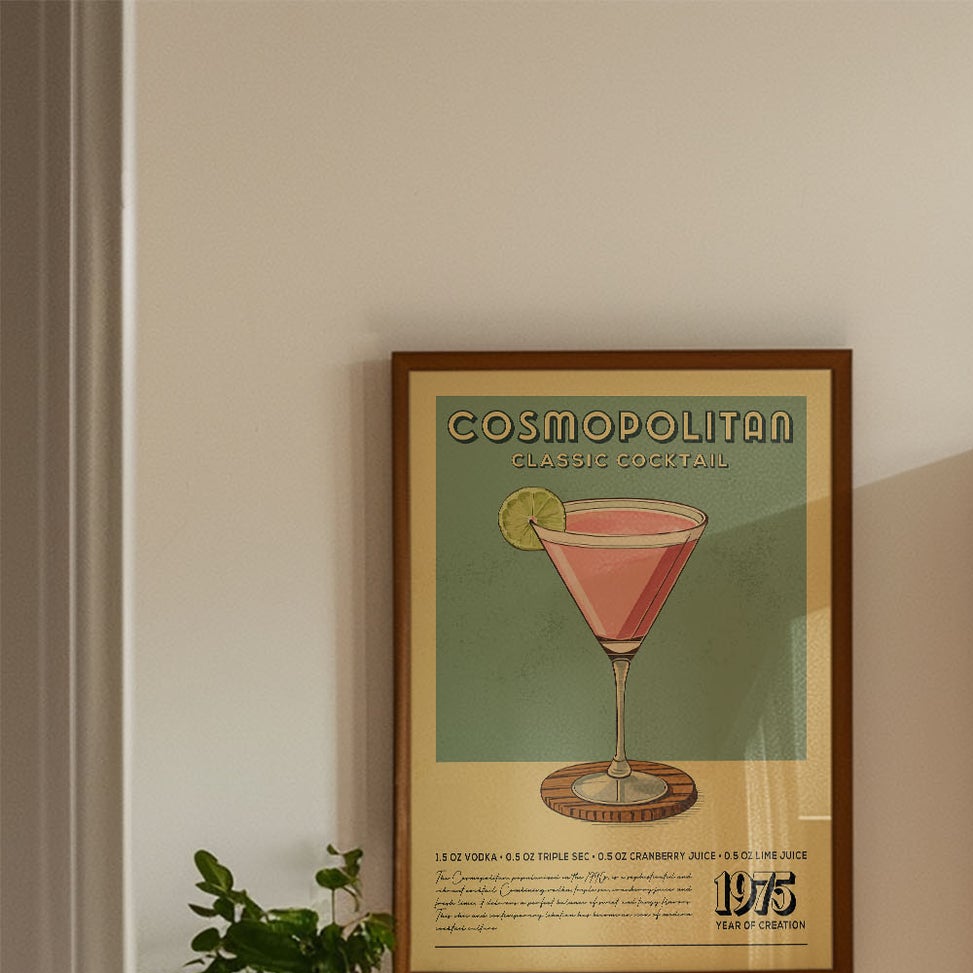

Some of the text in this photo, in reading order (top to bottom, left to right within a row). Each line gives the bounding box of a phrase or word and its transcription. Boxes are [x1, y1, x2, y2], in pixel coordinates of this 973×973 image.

[448, 409, 794, 444] COSMOPOLITAN
[511, 453, 729, 469] CLASSIC COCKTAIL
[435, 853, 448, 862] 1.5
[450, 853, 462, 861] OZ
[465, 853, 498, 862] VODKA
[506, 853, 520, 861] 0.5
[523, 853, 535, 861] OZ
[538, 852, 569, 861] TRIPLE
[571, 852, 590, 861] SEC
[598, 852, 613, 861] 0.5
[615, 852, 627, 861] OZ
[629, 852, 685, 861] CRANBERRY
[688, 851, 716, 861] JUICE
[741, 851, 754, 860] OZ
[755, 851, 777, 860] LIME
[779, 851, 807, 860] JUICE
[714, 870, 796, 917] 1975
[715, 921, 806, 930] YEAR OF CREATION
